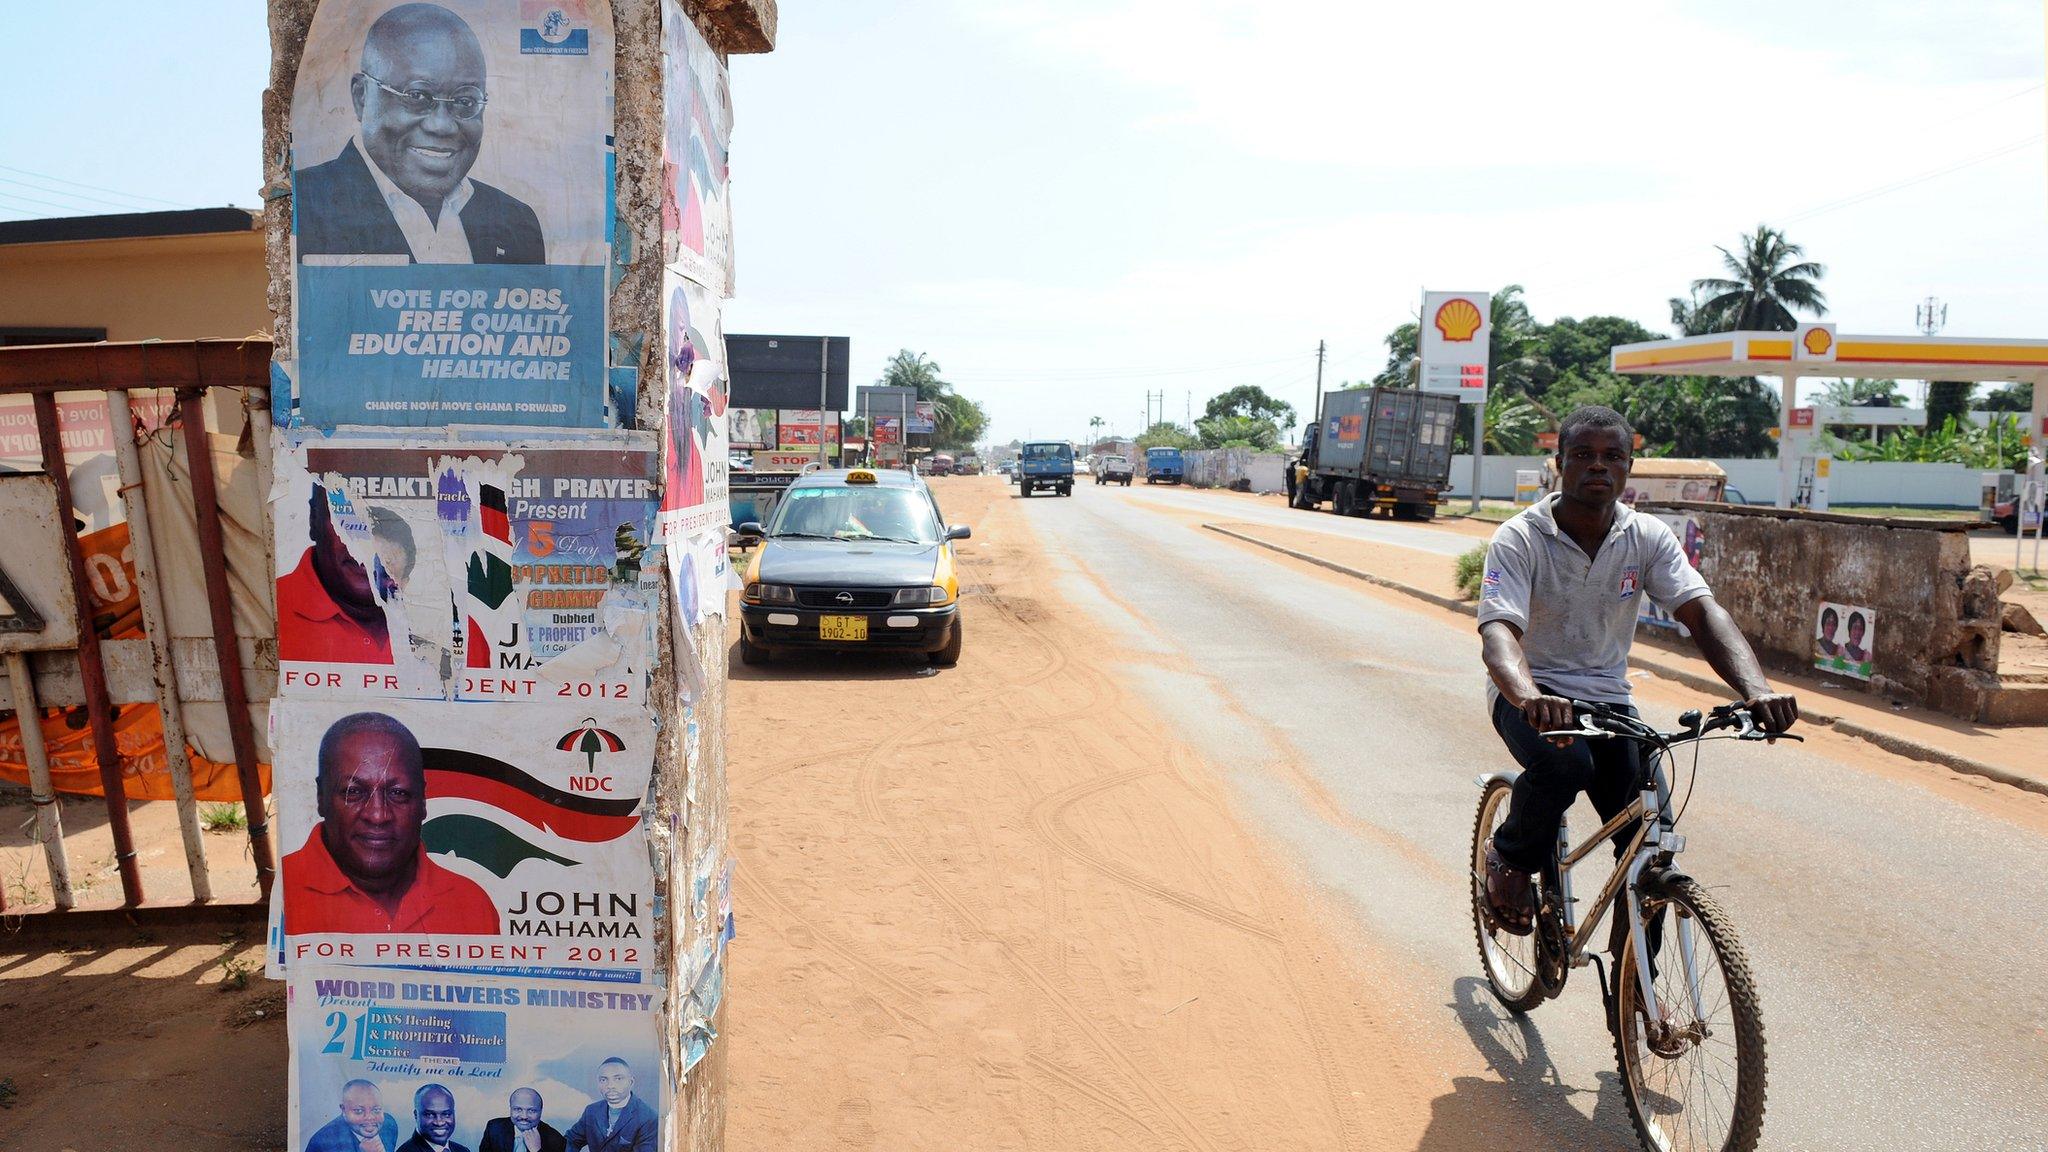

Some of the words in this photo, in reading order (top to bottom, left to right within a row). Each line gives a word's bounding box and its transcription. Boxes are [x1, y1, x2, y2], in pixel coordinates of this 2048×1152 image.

[370, 289, 432, 309] VOTE
[438, 289, 488, 309] FOR
[493, 287, 568, 315] JOBS,
[398, 310, 464, 332] FREE
[470, 313, 573, 335] QUALITY
[348, 334, 505, 355] EDUCATION
[508, 335, 571, 357] AND
[421, 359, 571, 381] HEALTHCARE
[365, 401, 408, 411] CHANGE
[410, 401, 439, 411] NOW!
[441, 402, 472, 411] MOVE
[474, 402, 513, 412] GHANA
[515, 403, 567, 413] FORWARD
[771, 456, 809, 465] STOP
[705, 461, 726, 483] JOHN
[849, 472, 873, 480] TAXI
[553, 478, 650, 499] PRAYER
[514, 500, 587, 519] Present
[527, 521, 555, 558] 5
[557, 535, 601, 559] Day
[553, 613, 595, 624] Dubbed
[836, 616, 849, 628] GT
[540, 626, 586, 642] PROPHET
[285, 671, 341, 687] FOR
[557, 682, 629, 699] 2012
[568, 775, 613, 792] NDC
[508, 890, 637, 917] JOHN
[509, 919, 643, 939] MAHAMA
[296, 942, 355, 959] FOR
[376, 943, 547, 960] PRESIDENT
[568, 947, 638, 962] 2012
[533, 967, 551, 975] will
[577, 969, 586, 977] be
[588, 970, 601, 978] the
[315, 979, 396, 1000] WORD
[402, 983, 521, 1006] DELIVERS
[527, 988, 653, 1011] MINISTRY
[370, 1013, 402, 1024] DAYS
[405, 1014, 452, 1030] Healing
[322, 1011, 367, 1060] 21
[369, 1031, 379, 1040] &
[383, 1031, 457, 1044] PROPHETIC
[459, 1034, 504, 1046] Miracle
[368, 1045, 410, 1057] Service
[366, 1061, 421, 1076] Identify
[425, 1066, 444, 1076] me
[447, 1065, 464, 1076] oh
[467, 1066, 502, 1078] Lord
[423, 1057, 458, 1066] THEME
